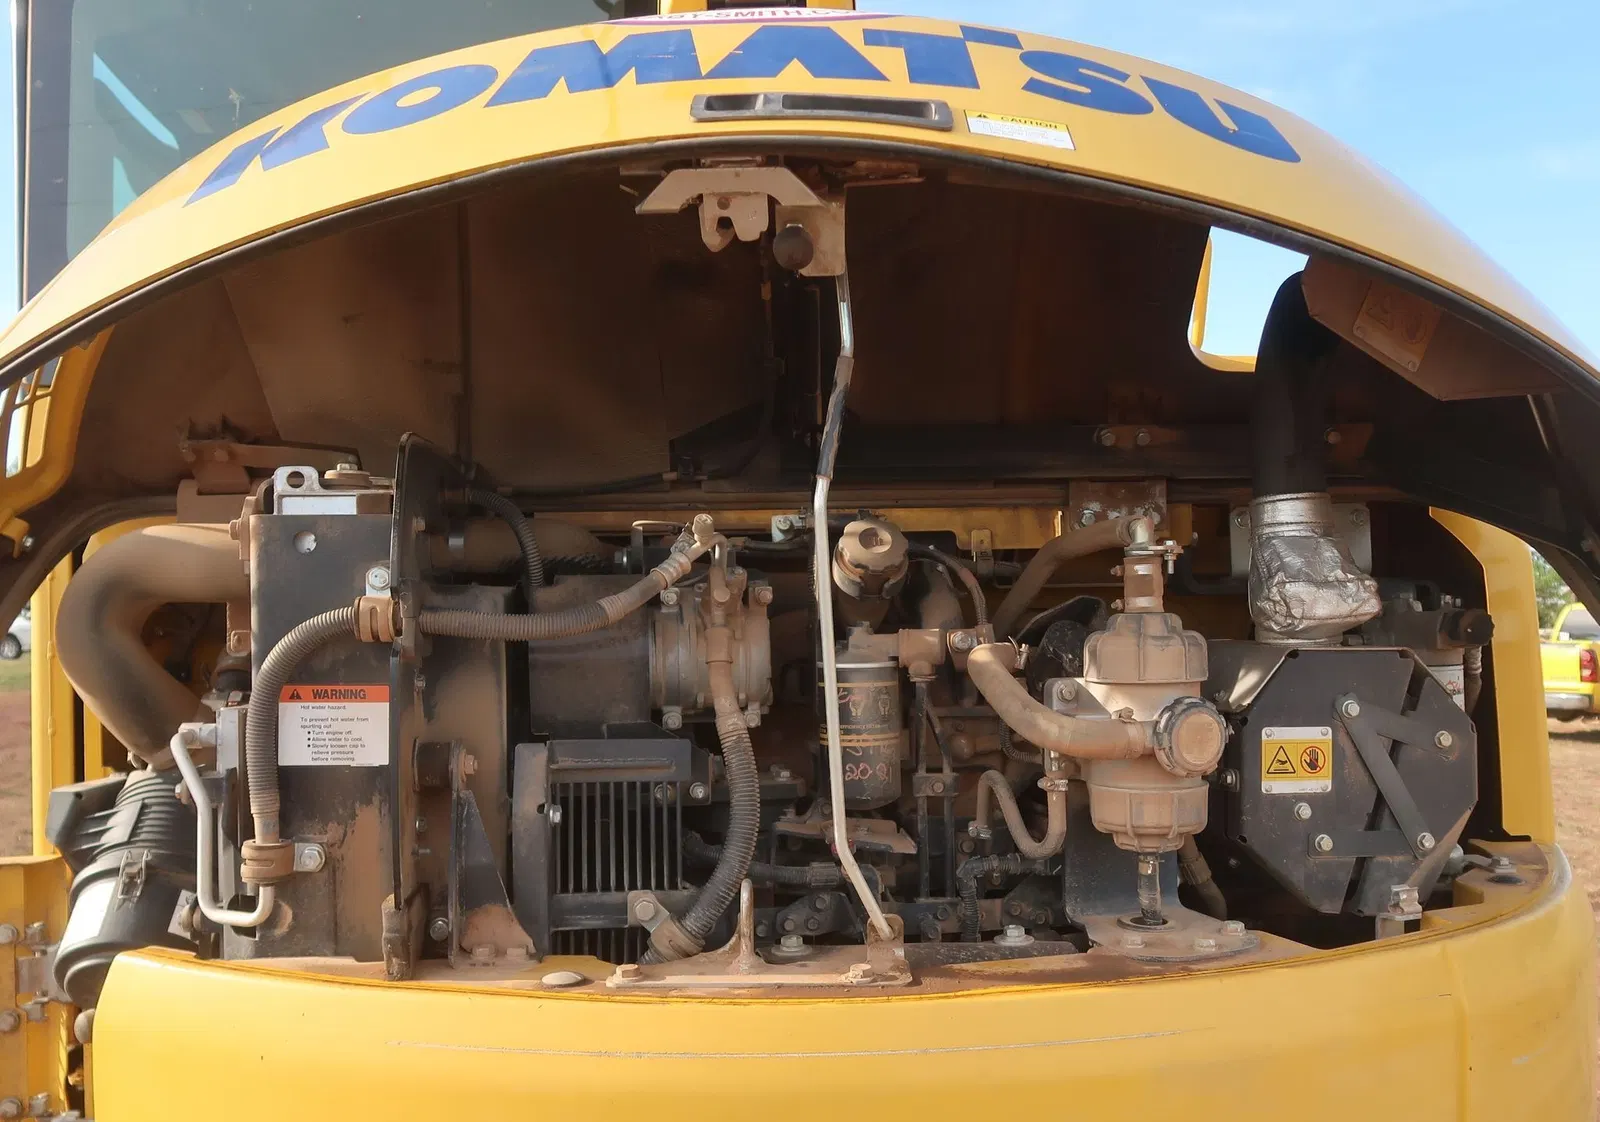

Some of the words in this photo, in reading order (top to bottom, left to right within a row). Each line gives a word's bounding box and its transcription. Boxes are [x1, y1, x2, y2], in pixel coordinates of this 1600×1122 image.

[182, 26, 1301, 163] KOMATSU
[1001, 115, 1058, 130] CAUTION
[311, 688, 367, 700] WARNING
